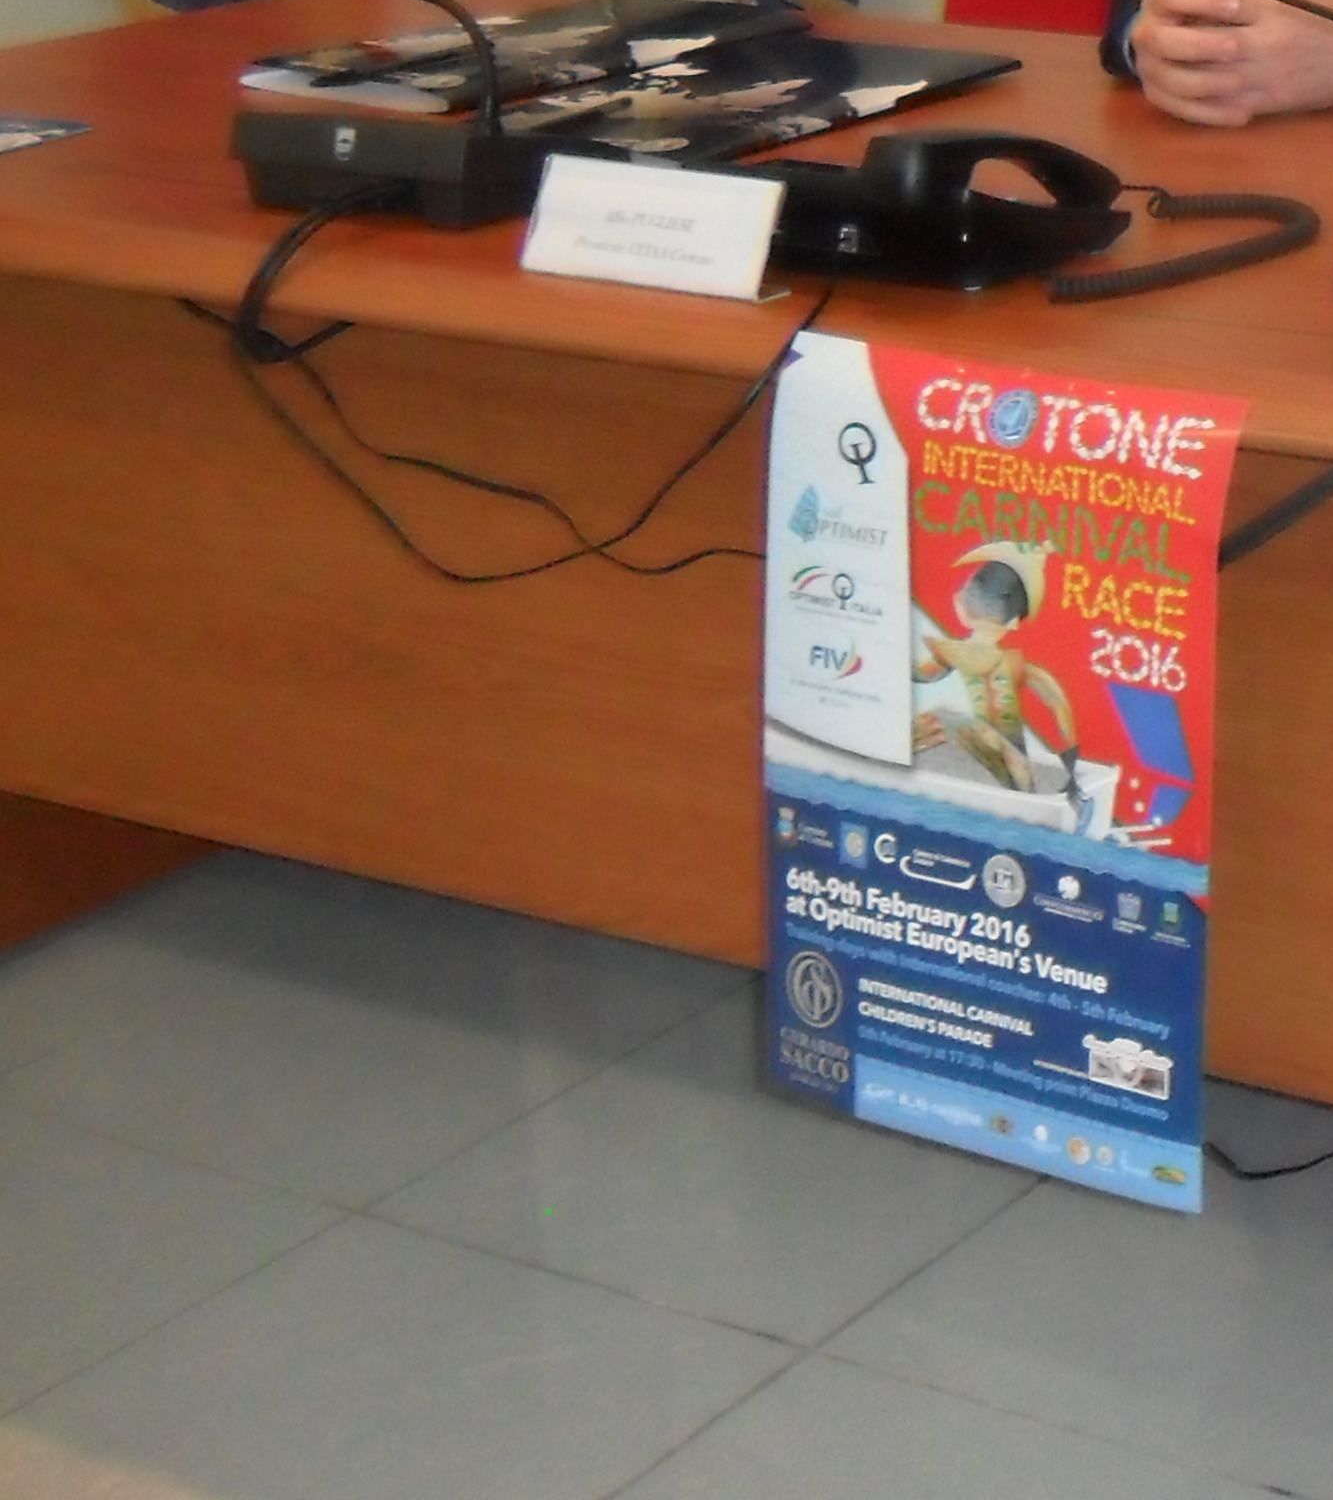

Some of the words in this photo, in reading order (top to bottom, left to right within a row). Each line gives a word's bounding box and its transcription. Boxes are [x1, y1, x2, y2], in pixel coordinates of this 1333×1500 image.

[917, 377, 1215, 479] CROTONE
[924, 441, 1196, 525] INTERNATIONAL
[914, 482, 1190, 582] CARNIVAL
[1061, 563, 1188, 639] RACE
[809, 646, 848, 671] FIV
[1090, 629, 1187, 691] 2016
[786, 867, 863, 907] 6th-9th
[867, 888, 968, 937] February
[970, 912, 1032, 949] 2016
[786, 896, 807, 917] at
[809, 898, 903, 942] Optimist
[907, 922, 1032, 975] European's
[1035, 953, 1109, 994] Venue
[858, 977, 965, 1017] INTERNATIONAL
[967, 1005, 1034, 1037] CARNIVAL
[858, 1001, 937, 1034] CHILDREN'S
[939, 1022, 994, 1049] PARADE
